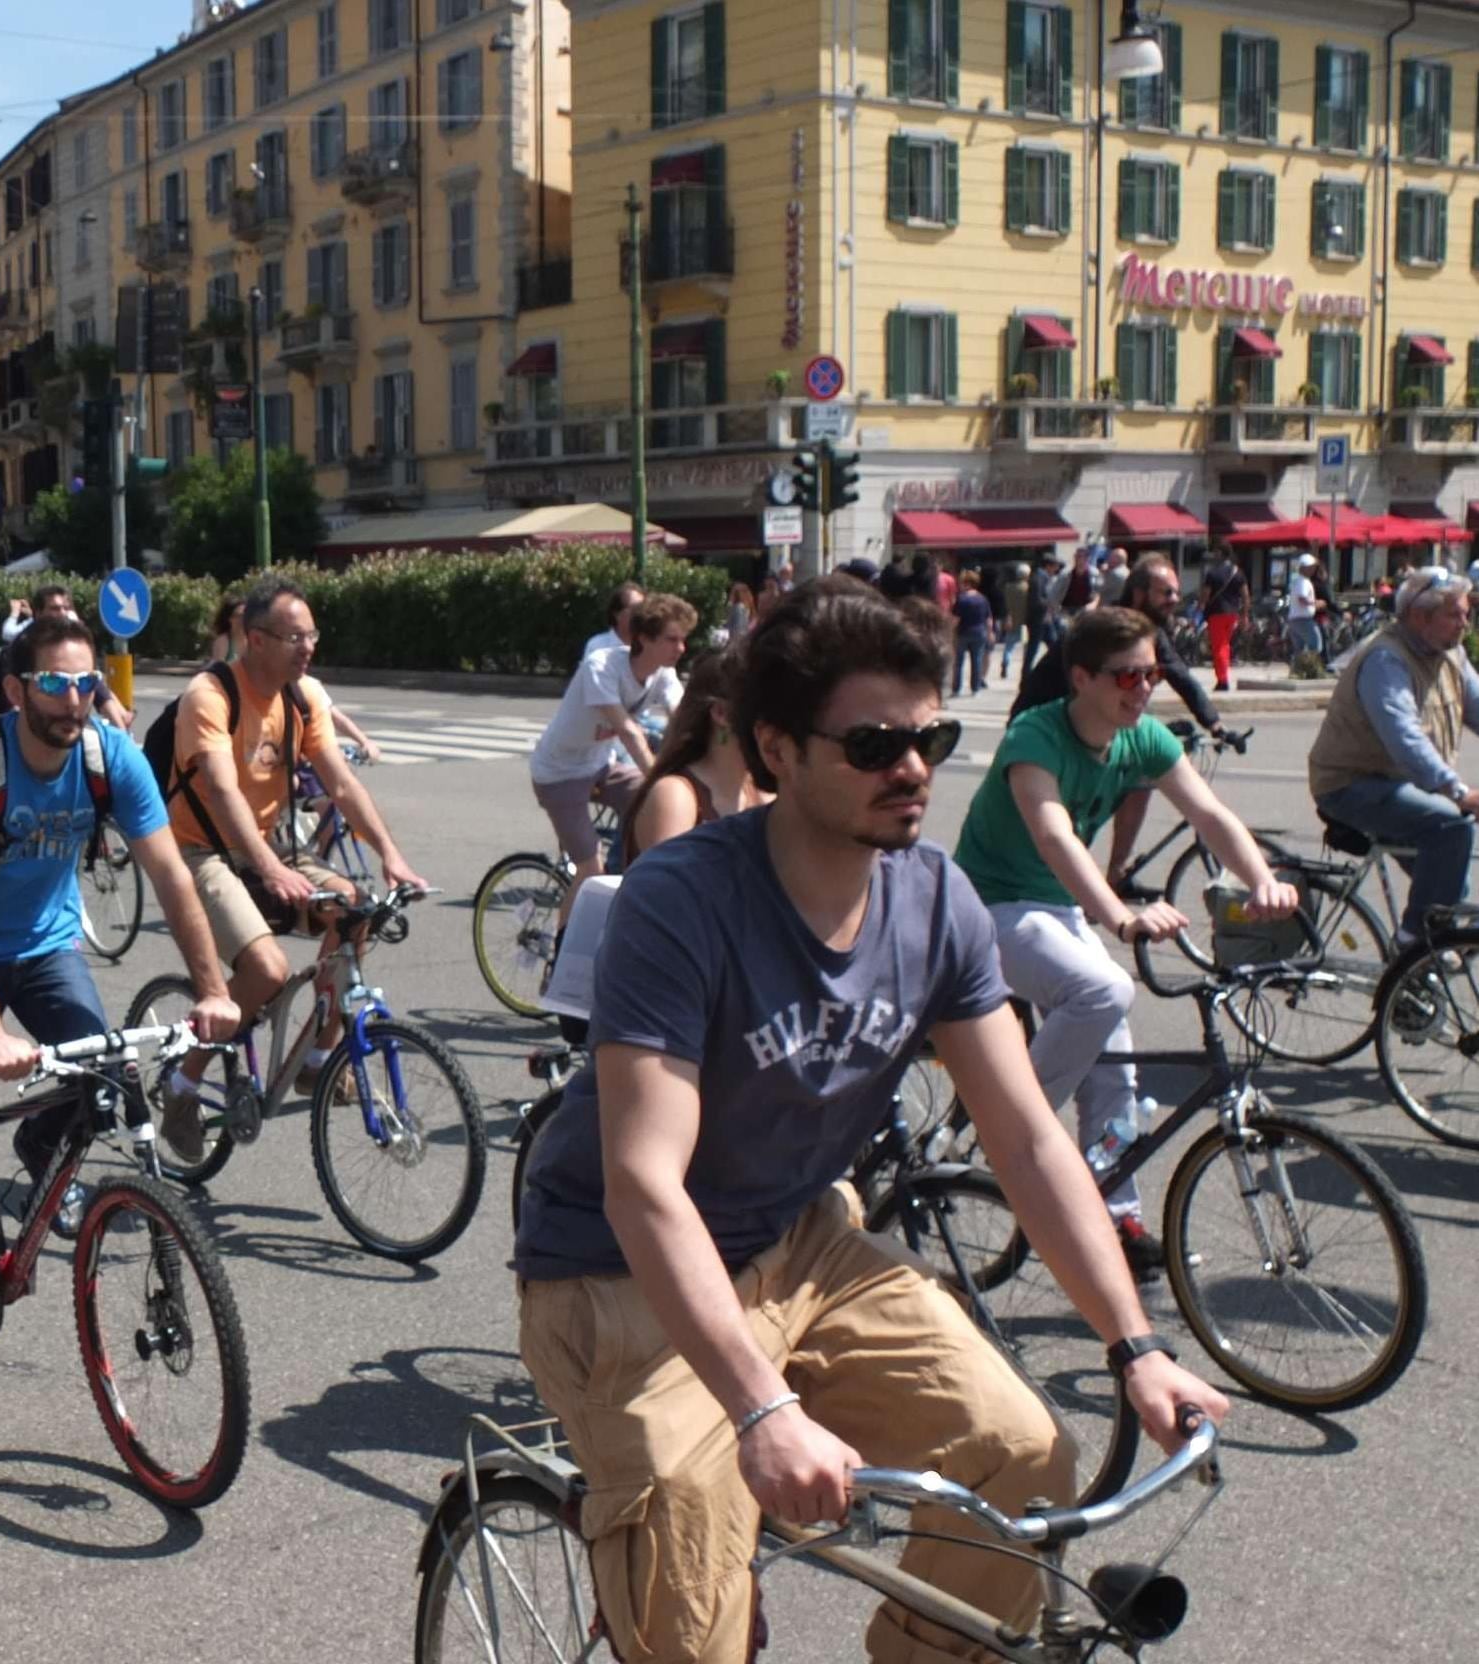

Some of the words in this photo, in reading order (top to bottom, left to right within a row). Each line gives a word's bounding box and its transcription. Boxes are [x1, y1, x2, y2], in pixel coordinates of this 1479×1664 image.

[1121, 251, 1295, 315] Mercure
[1299, 293, 1366, 318] HOTEL
[1326, 441, 1340, 463] P
[743, 998, 917, 1072] HILFIER
